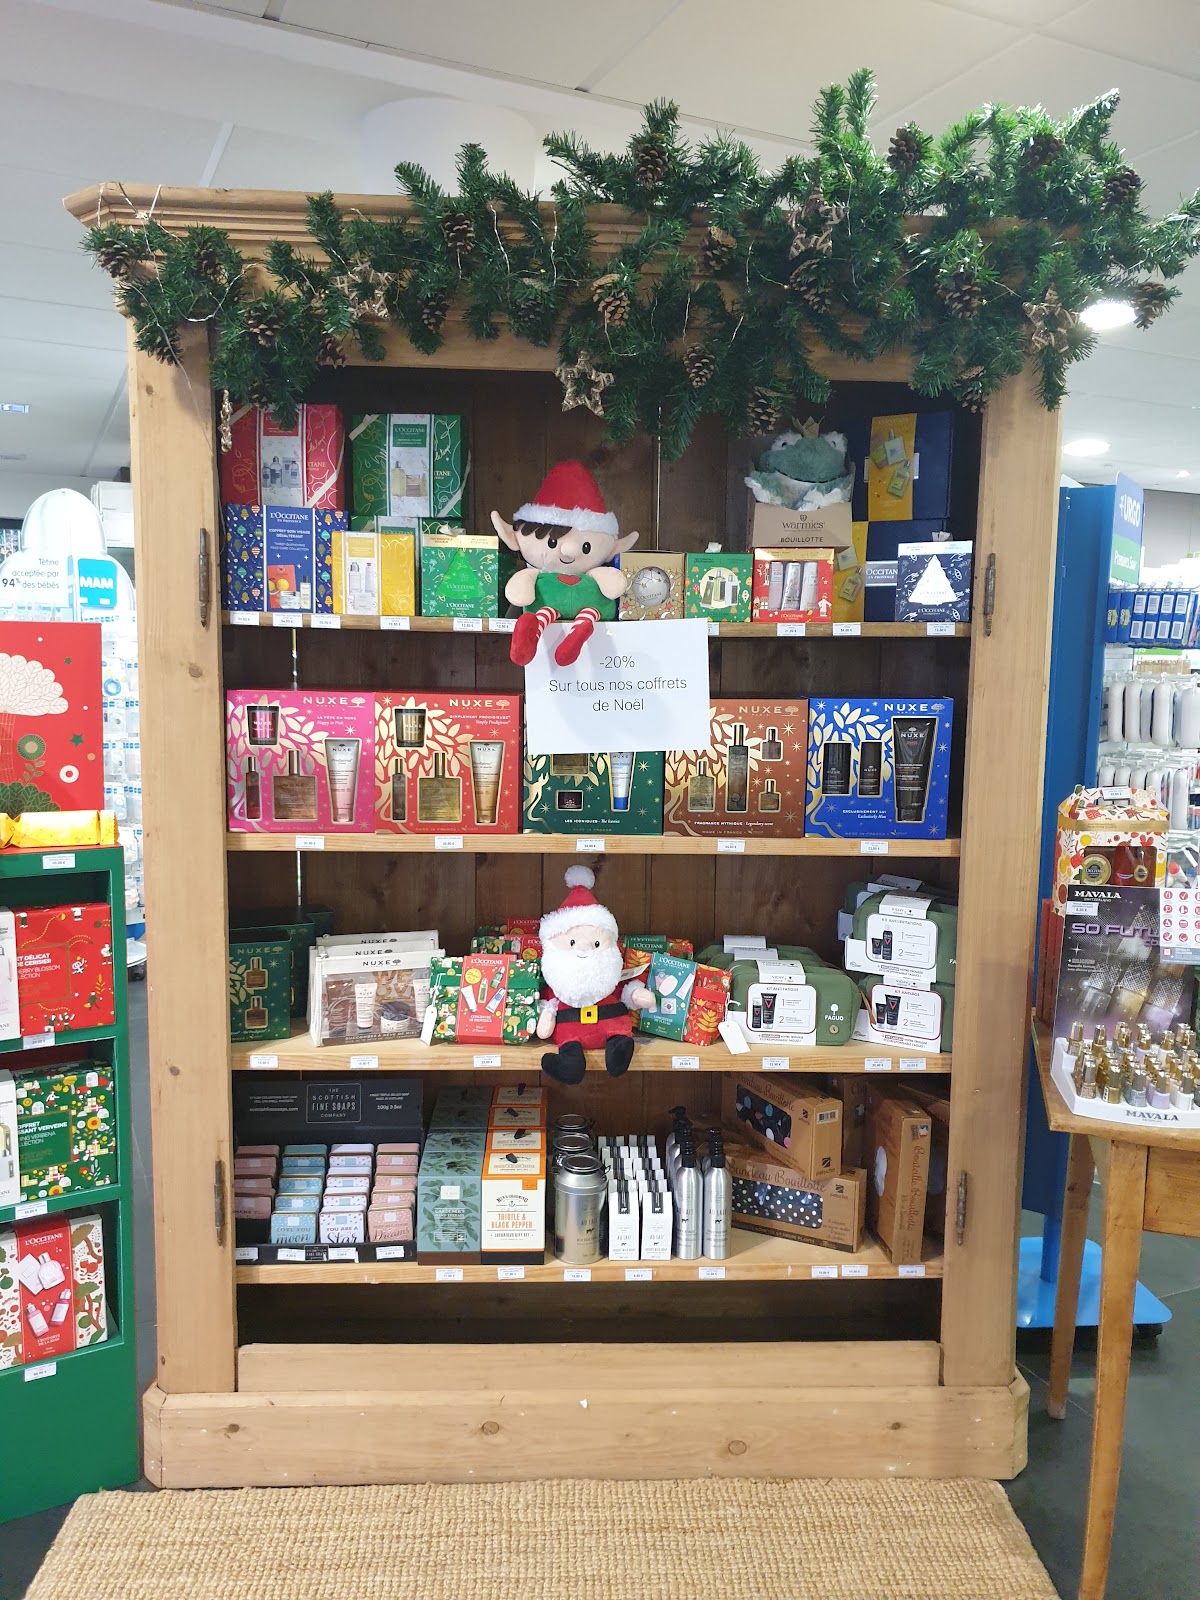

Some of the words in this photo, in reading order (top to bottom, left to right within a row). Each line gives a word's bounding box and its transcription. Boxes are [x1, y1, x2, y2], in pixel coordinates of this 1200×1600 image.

[270, 512, 309, 520] L'OCCITANE
[1123, 494, 1140, 528] URGO
[22, 581, 36, 589] des
[80, 576, 114, 590] MAM
[600, 656, 636, 669] -20%
[549, 680, 571, 692] Sur
[576, 680, 605, 691] tous
[610, 680, 633, 691] nos
[637, 677, 687, 690] coffrets
[304, 697, 348, 705] NUXE
[450, 700, 493, 708] NUXE
[592, 700, 610, 711] de
[614, 698, 644, 711] Noël
[739, 706, 782, 714] NUXE
[1075, 890, 1122, 899] MAVALA
[1072, 923, 1101, 935] SO
[660, 956, 690, 969] L'OCCITANE
[35, 965, 61, 973] BLOSSOM
[312, 1102, 329, 1111] FINE
[332, 1102, 356, 1110] SOAPS
[1126, 1110, 1180, 1121] MAVALA
[38, 1122, 68, 1132] VERVEINE
[727, 1158, 771, 1181] Bandeau
[775, 1170, 825, 1193] Bouillotte
[492, 1221, 510, 1229] BLACK
[512, 1221, 533, 1229] PEPPER
[25, 1233, 63, 1246] L'OCCITANE
[277, 1234, 309, 1244] moon
[327, 1232, 358, 1243] Star
